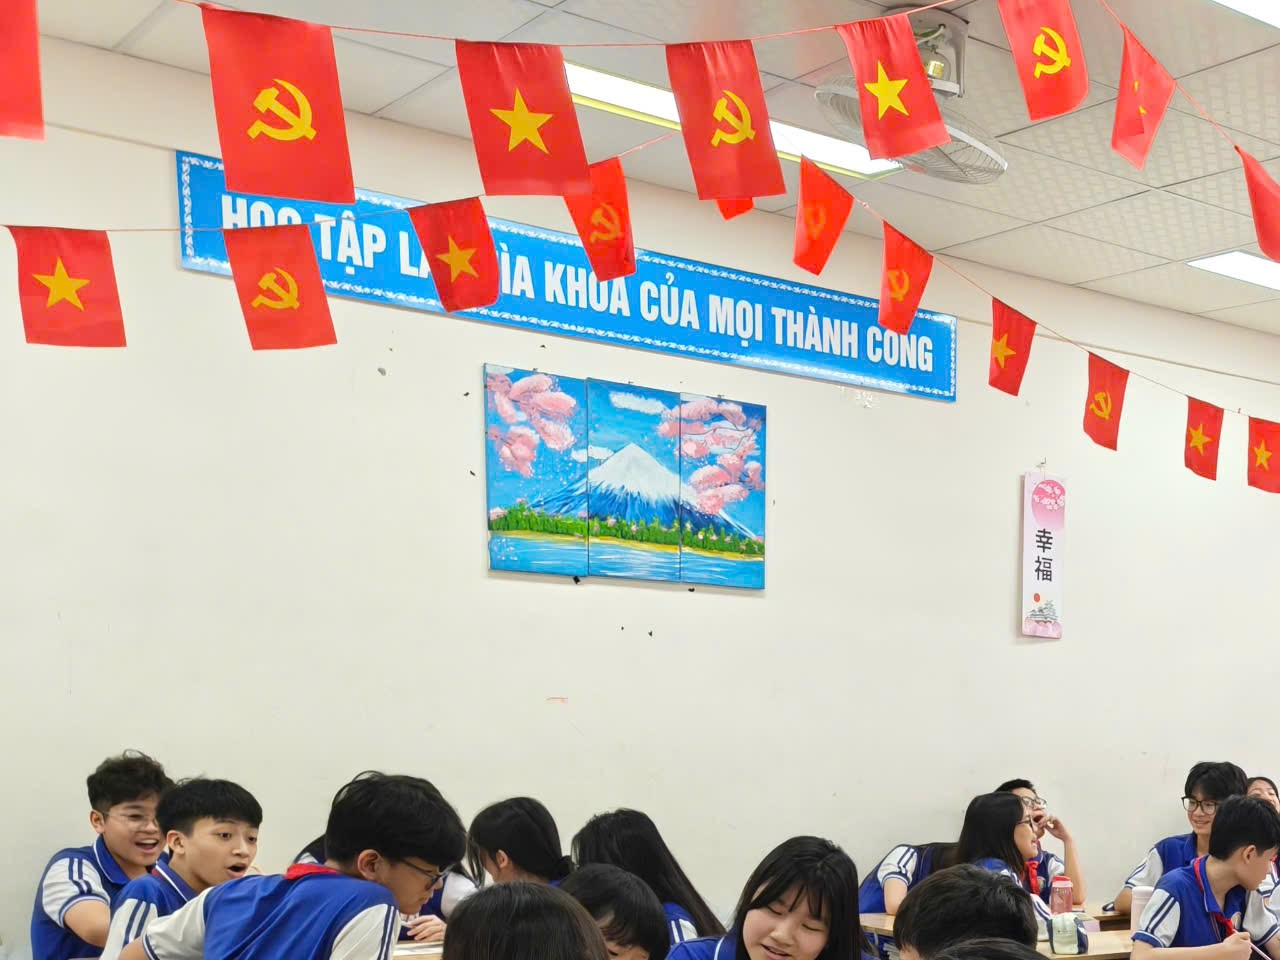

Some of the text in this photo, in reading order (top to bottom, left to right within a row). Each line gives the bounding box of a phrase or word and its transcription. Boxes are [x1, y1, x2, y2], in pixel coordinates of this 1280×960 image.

[314, 210, 387, 275] TẬP
[639, 272, 700, 329] CỦA
[708, 294, 762, 347] MỌI
[771, 306, 858, 359] THÀNH
[1034, 528, 1053, 582] 幸福
